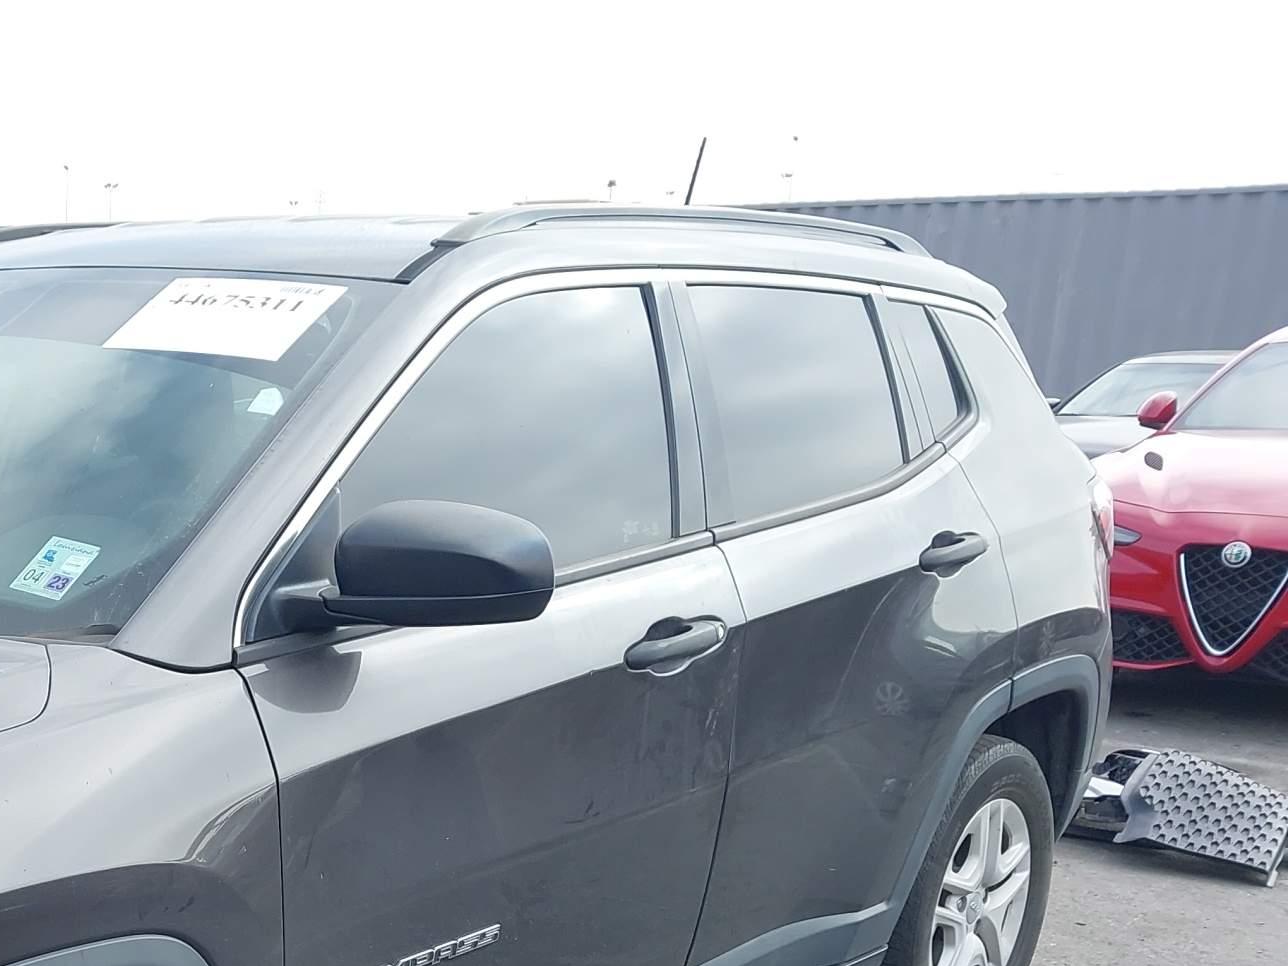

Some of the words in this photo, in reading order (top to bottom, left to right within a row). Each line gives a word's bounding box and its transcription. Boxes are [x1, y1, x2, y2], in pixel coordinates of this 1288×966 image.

[168, 292, 305, 312] 44675311
[22, 567, 46, 585] 04
[47, 574, 70, 591] 23
